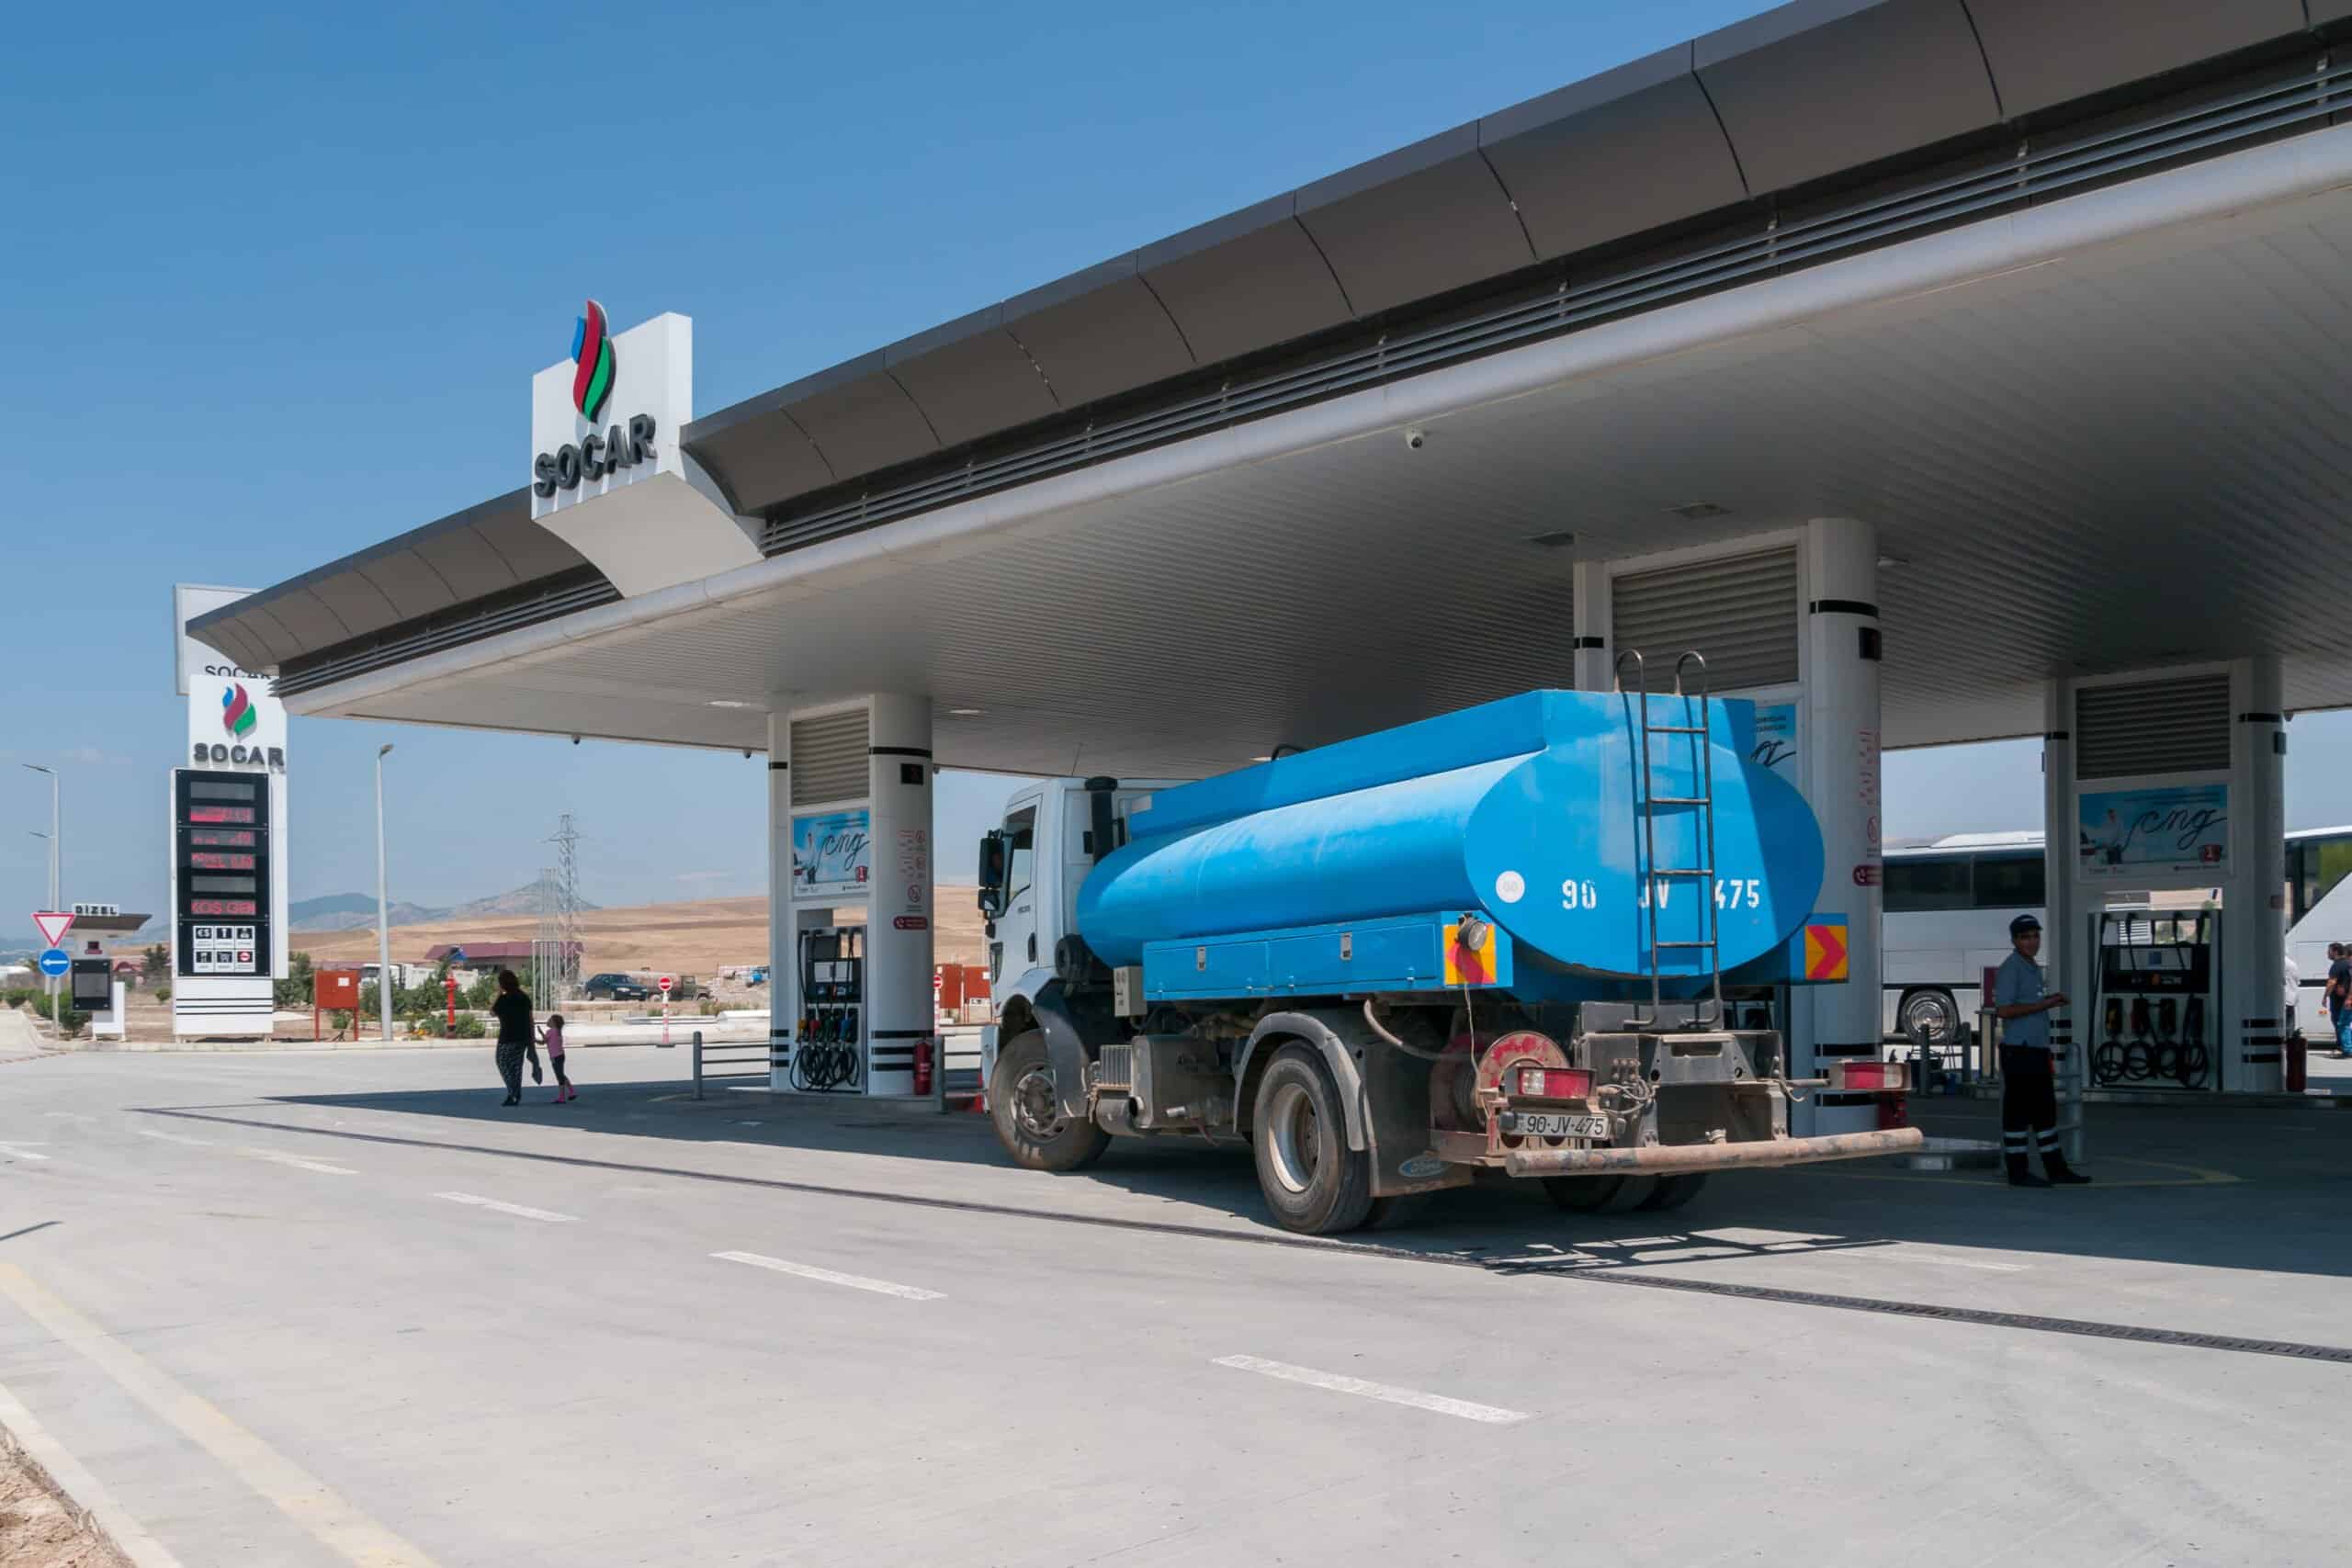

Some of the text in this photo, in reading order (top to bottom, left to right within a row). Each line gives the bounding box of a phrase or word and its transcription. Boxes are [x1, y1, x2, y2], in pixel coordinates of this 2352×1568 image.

[534, 413, 658, 498] SOCAR
[194, 743, 285, 766] SOCAR
[2133, 808, 2227, 851] cng
[1563, 879, 1597, 909] 90
[1714, 879, 1759, 909] 475
